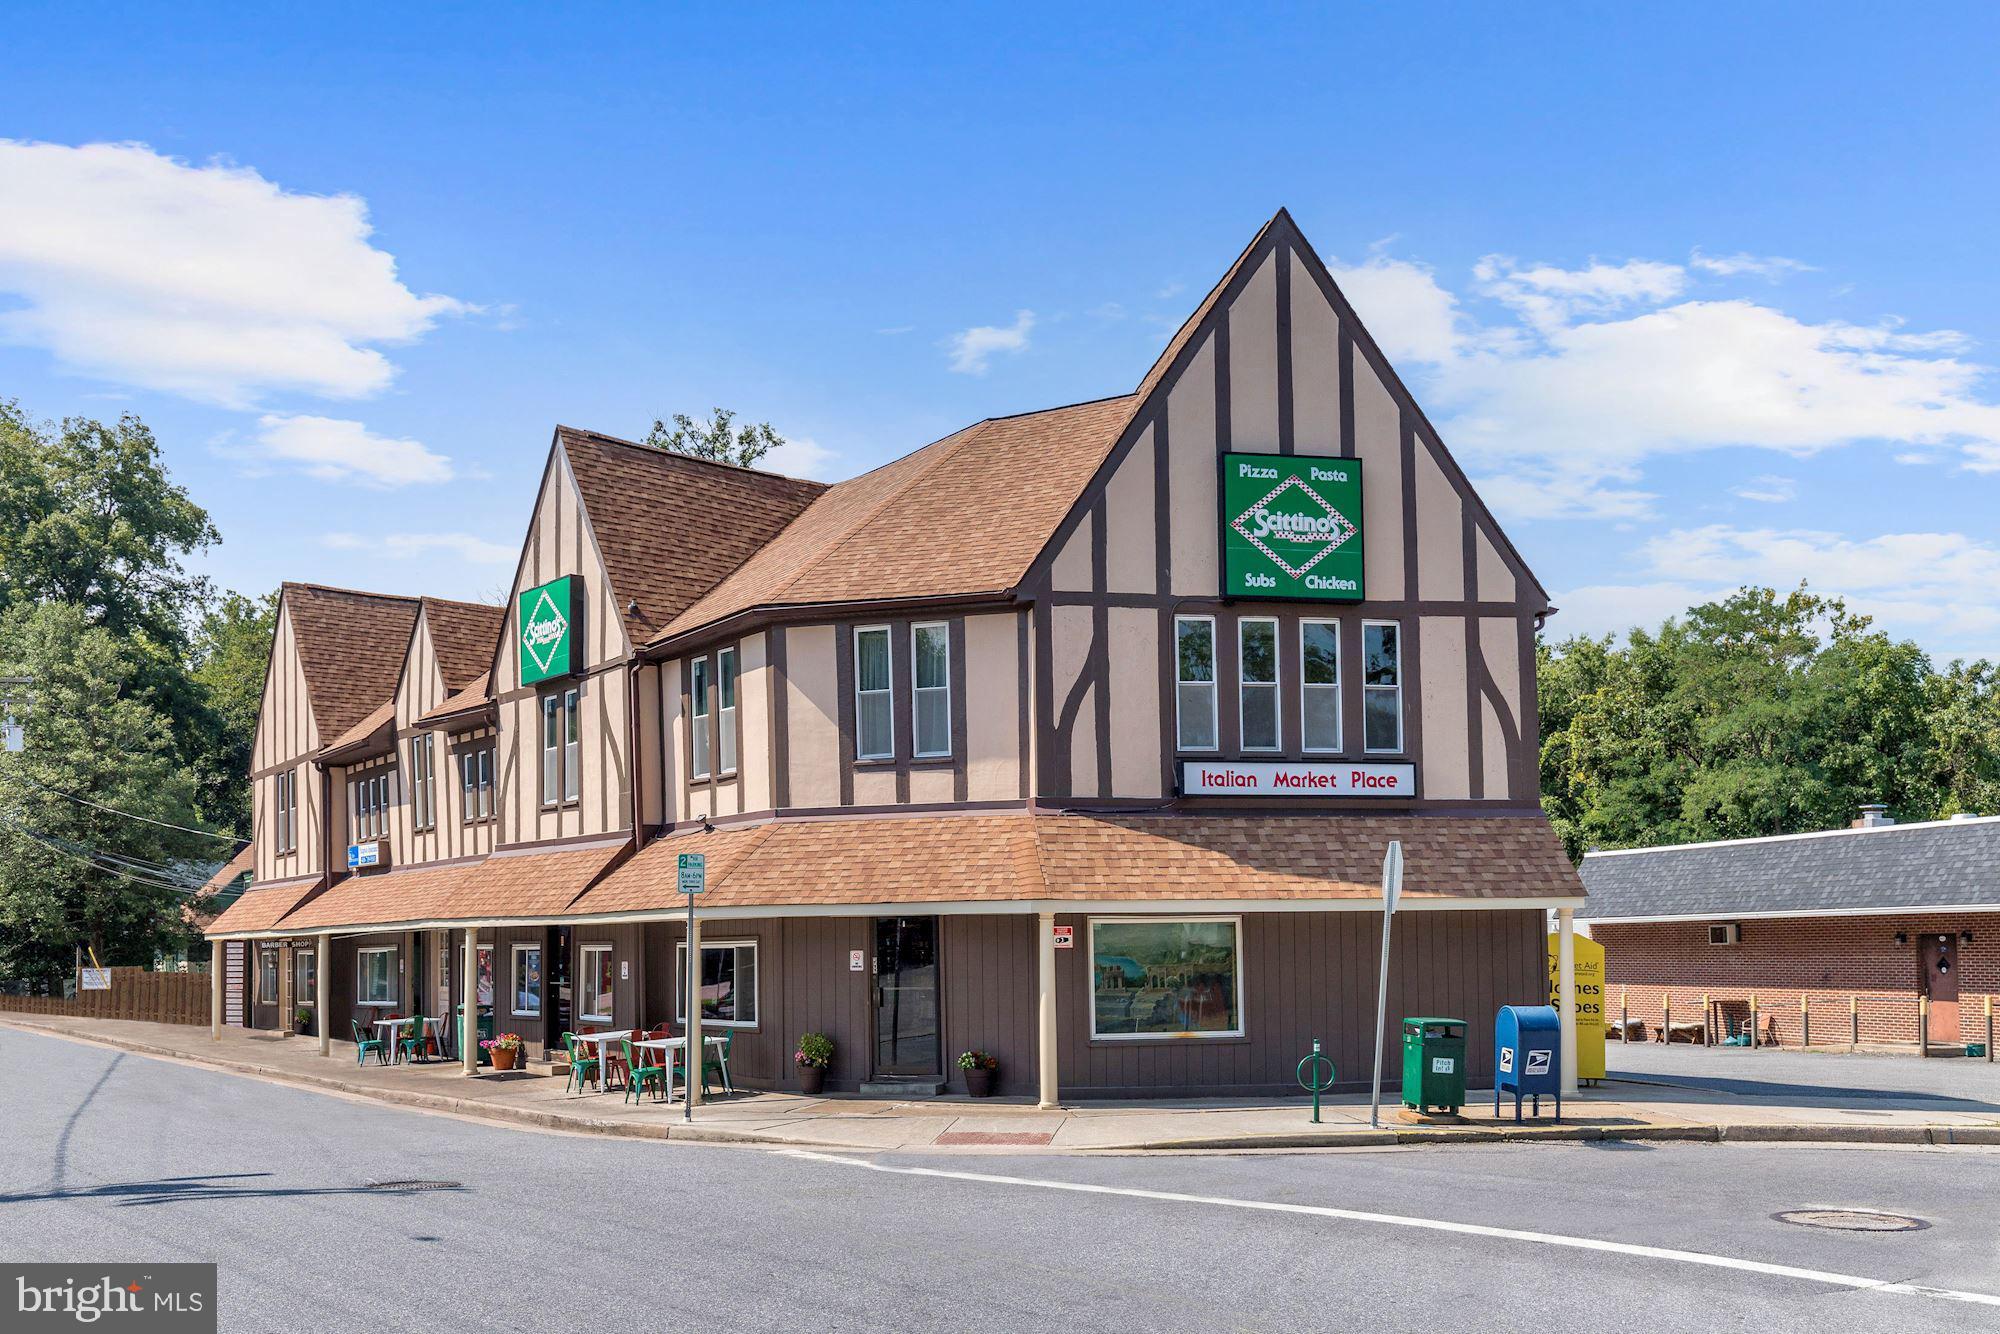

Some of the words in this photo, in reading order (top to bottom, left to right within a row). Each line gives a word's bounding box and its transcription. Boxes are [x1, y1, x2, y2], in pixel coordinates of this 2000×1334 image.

[1239, 463, 1278, 479] Pizza
[1310, 466, 1348, 482] Pasta
[1253, 508, 1341, 541] Scittino's
[1244, 572, 1277, 588] Subs
[1305, 574, 1357, 590] Chicken
[1201, 770, 1257, 788] Italian
[1273, 771, 1337, 788] Market
[1351, 771, 1398, 788] Place
[680, 856, 687, 867] 2
[291, 940, 309, 948] SHOP
